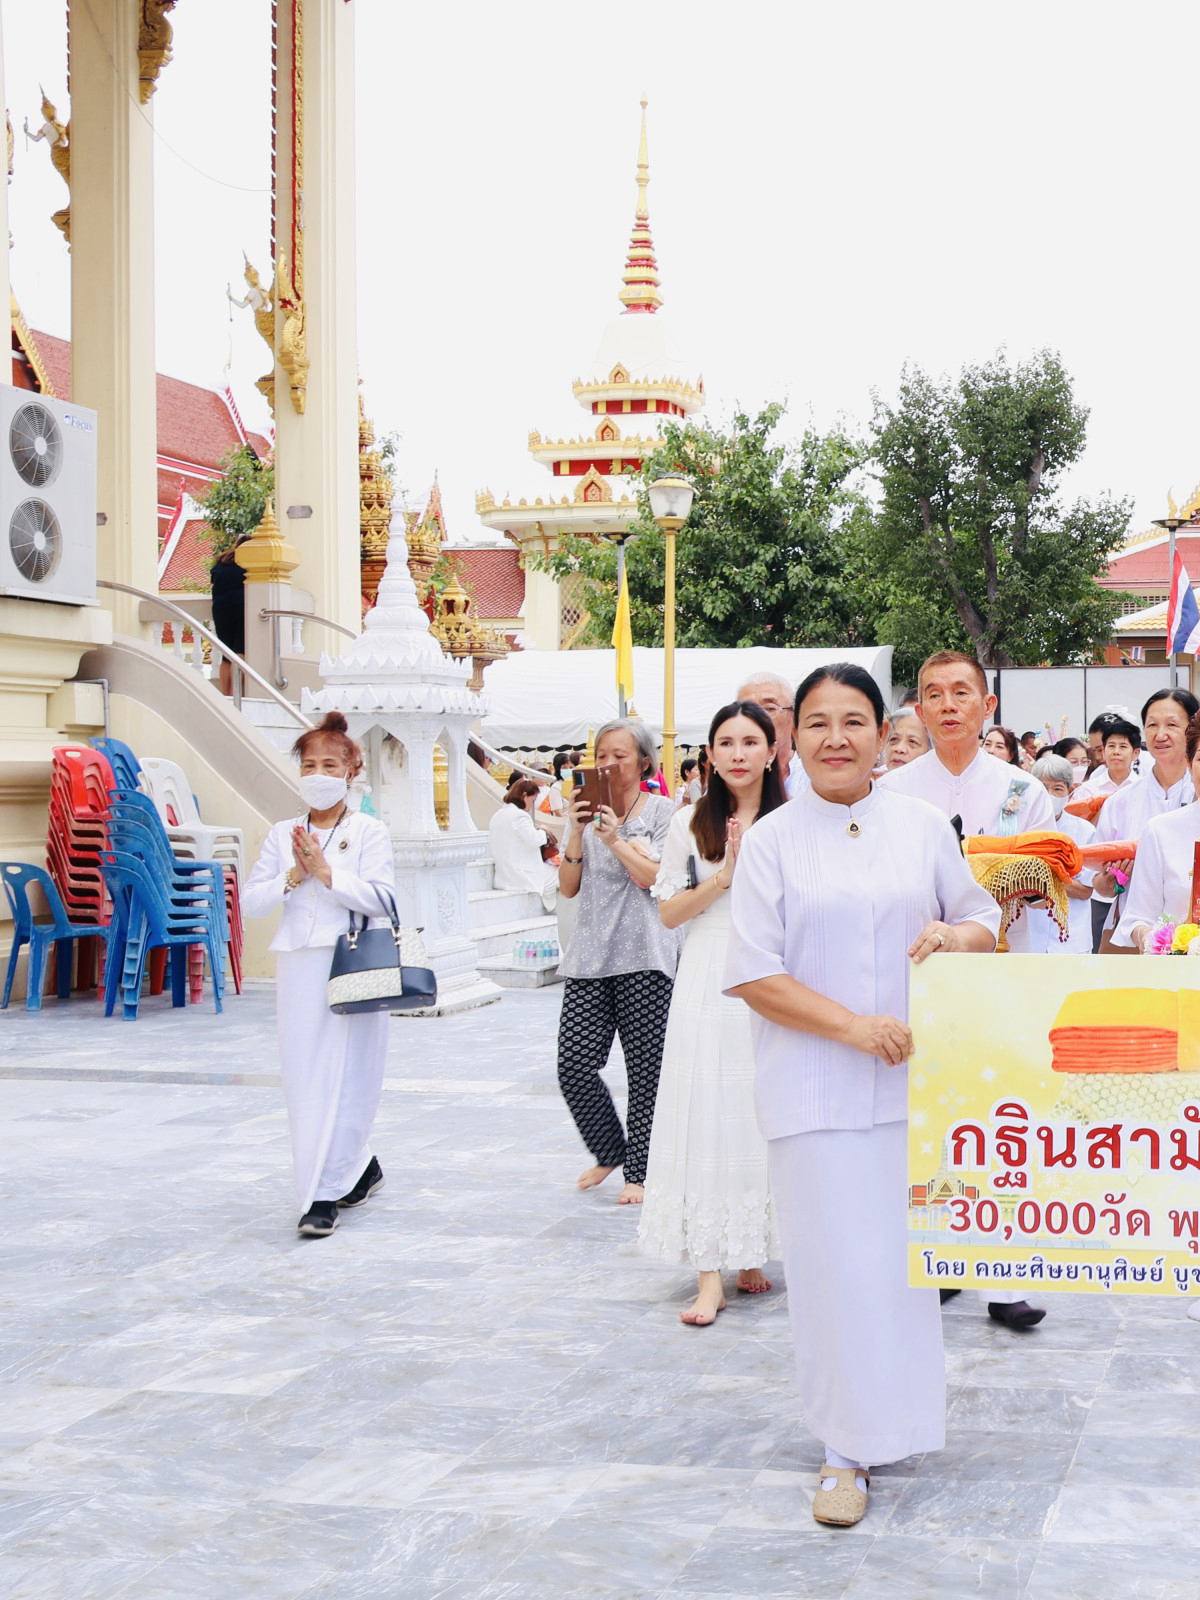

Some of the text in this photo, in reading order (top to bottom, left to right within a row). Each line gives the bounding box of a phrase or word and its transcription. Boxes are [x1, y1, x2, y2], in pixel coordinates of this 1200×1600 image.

[71, 415, 93, 431] Focus
[923, 1252, 965, 1276] โดย
[975, 1257, 1165, 1288] คณะศิษยานุศิษย์
